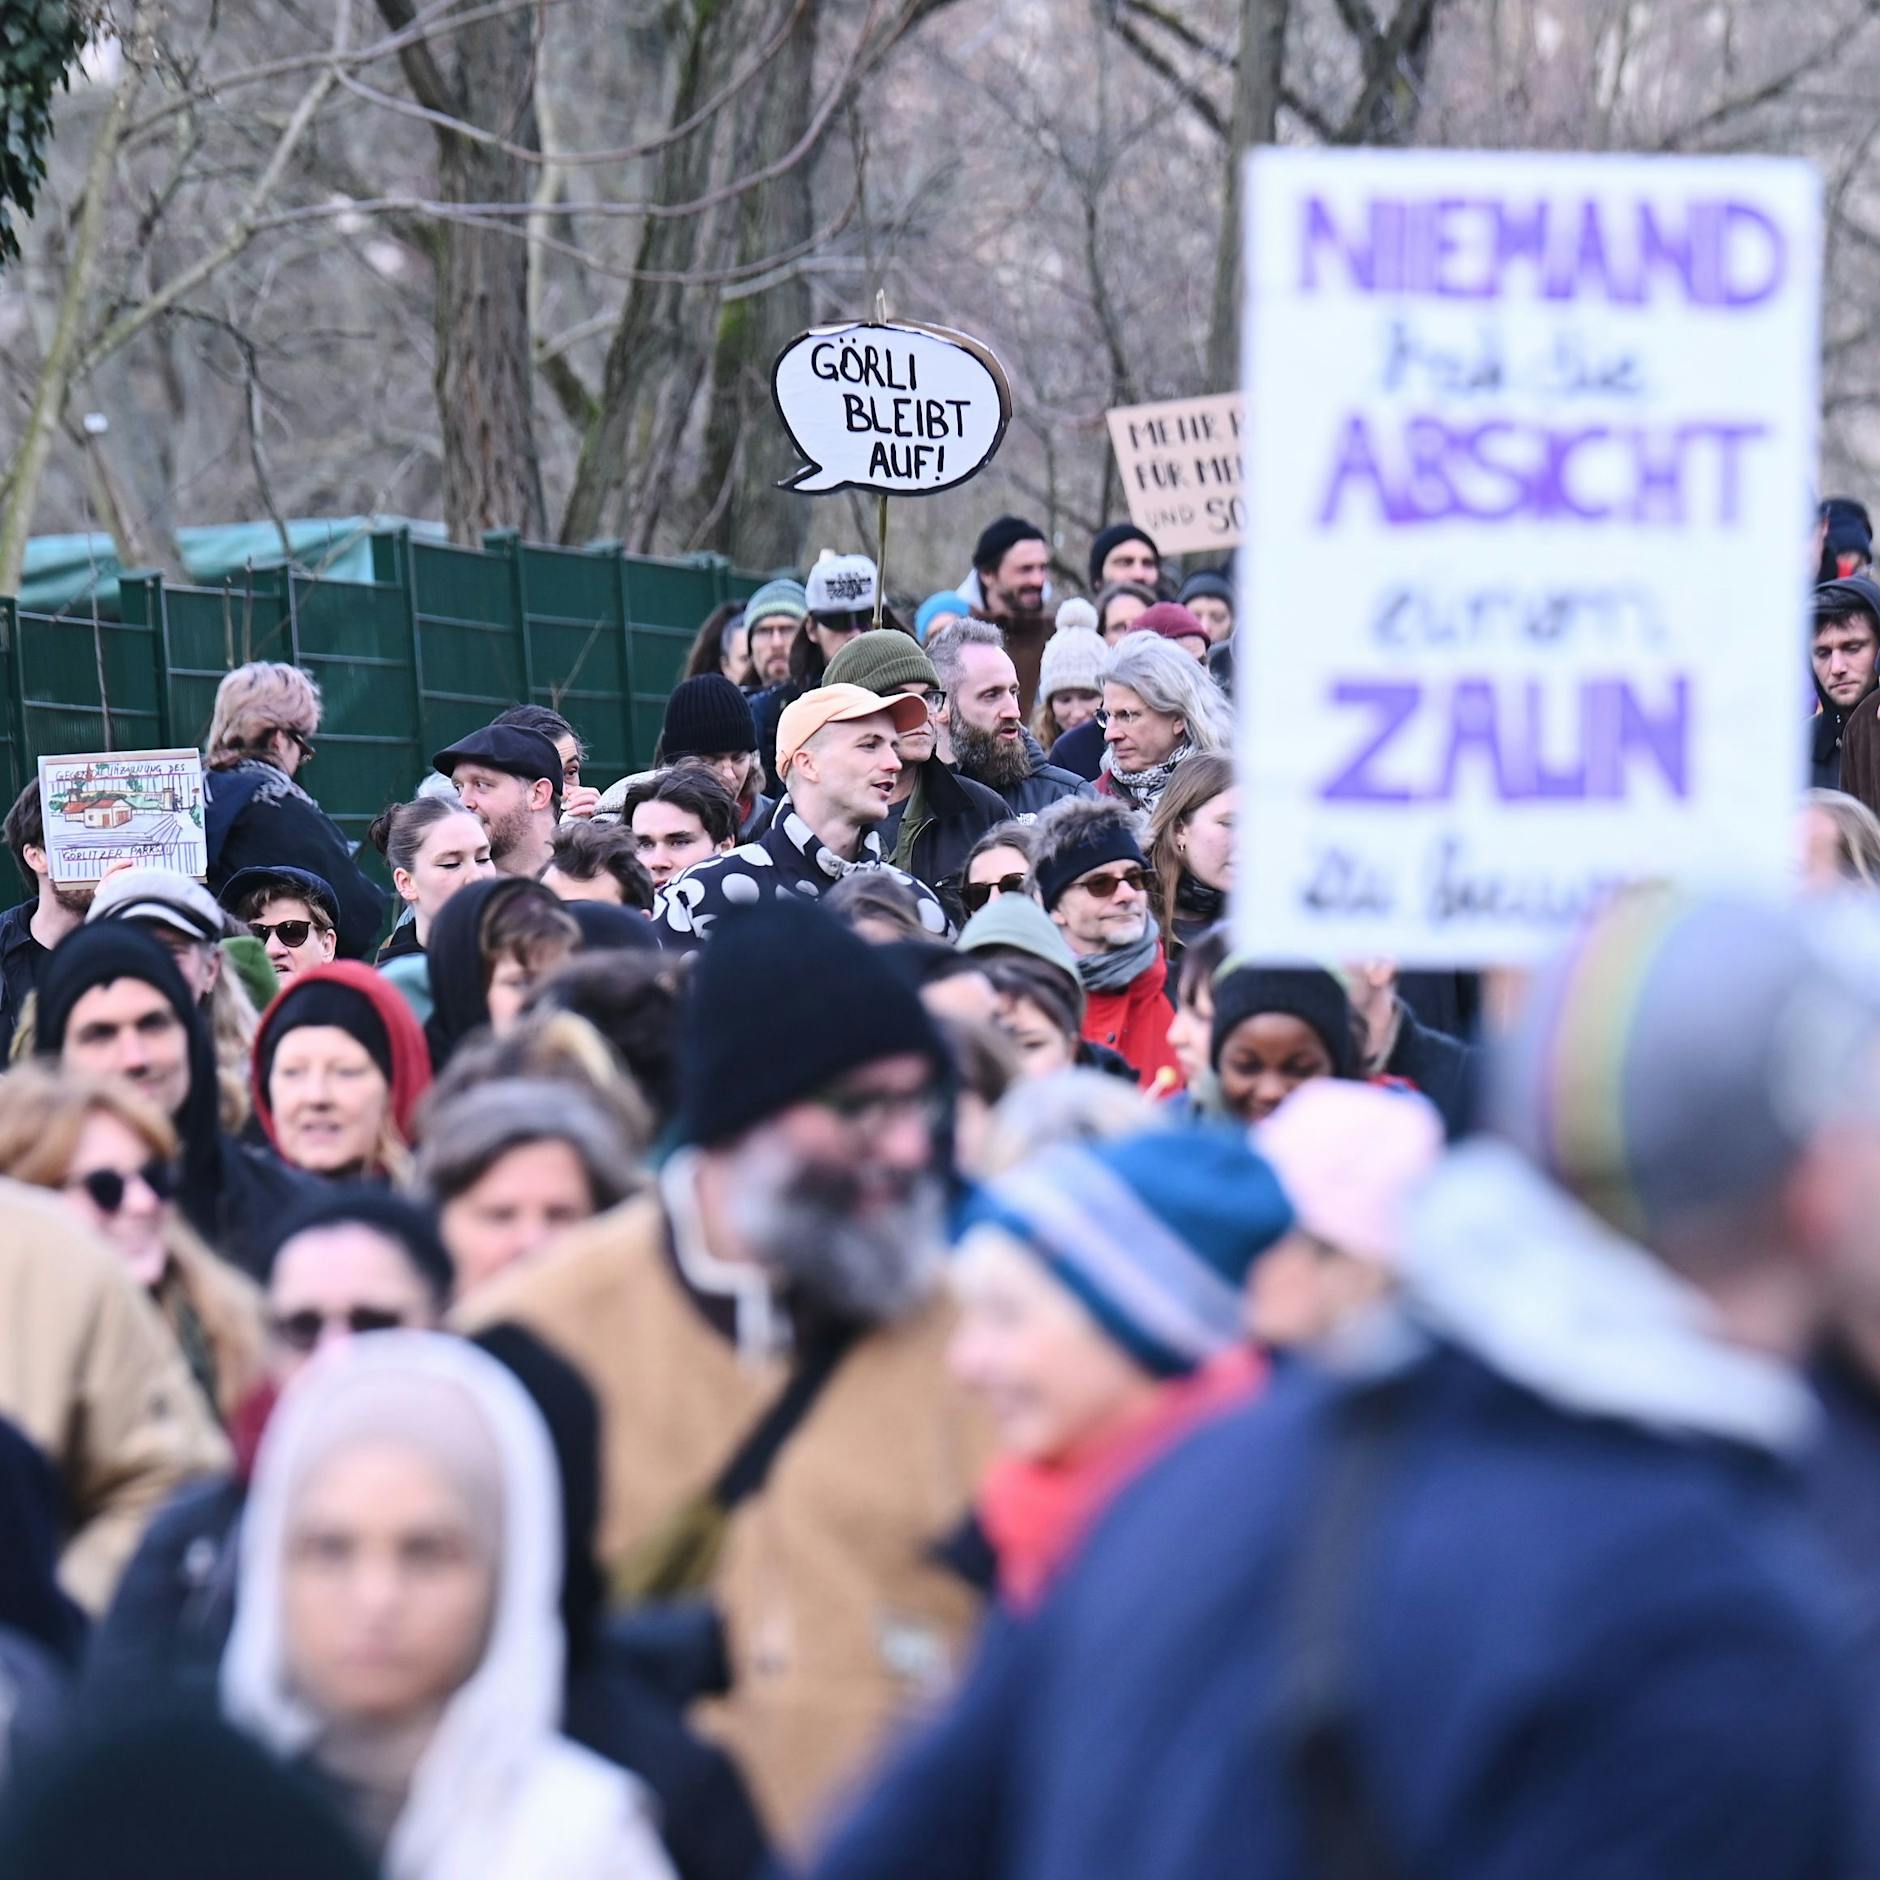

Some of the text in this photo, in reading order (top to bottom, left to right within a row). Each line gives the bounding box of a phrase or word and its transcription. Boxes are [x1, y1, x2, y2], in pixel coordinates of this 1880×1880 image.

[1298, 193, 1789, 308] NIEMAND
[811, 337, 917, 391] GÖRLI
[842, 394, 971, 439] BLEIBT
[1128, 413, 1222, 450] MEHR
[869, 442, 945, 481] AUF!
[1317, 412, 1770, 530] ABSICHT
[1145, 505, 1194, 532] UND
[1320, 673, 1692, 807] ZAUN
[169, 763, 185, 773] DES
